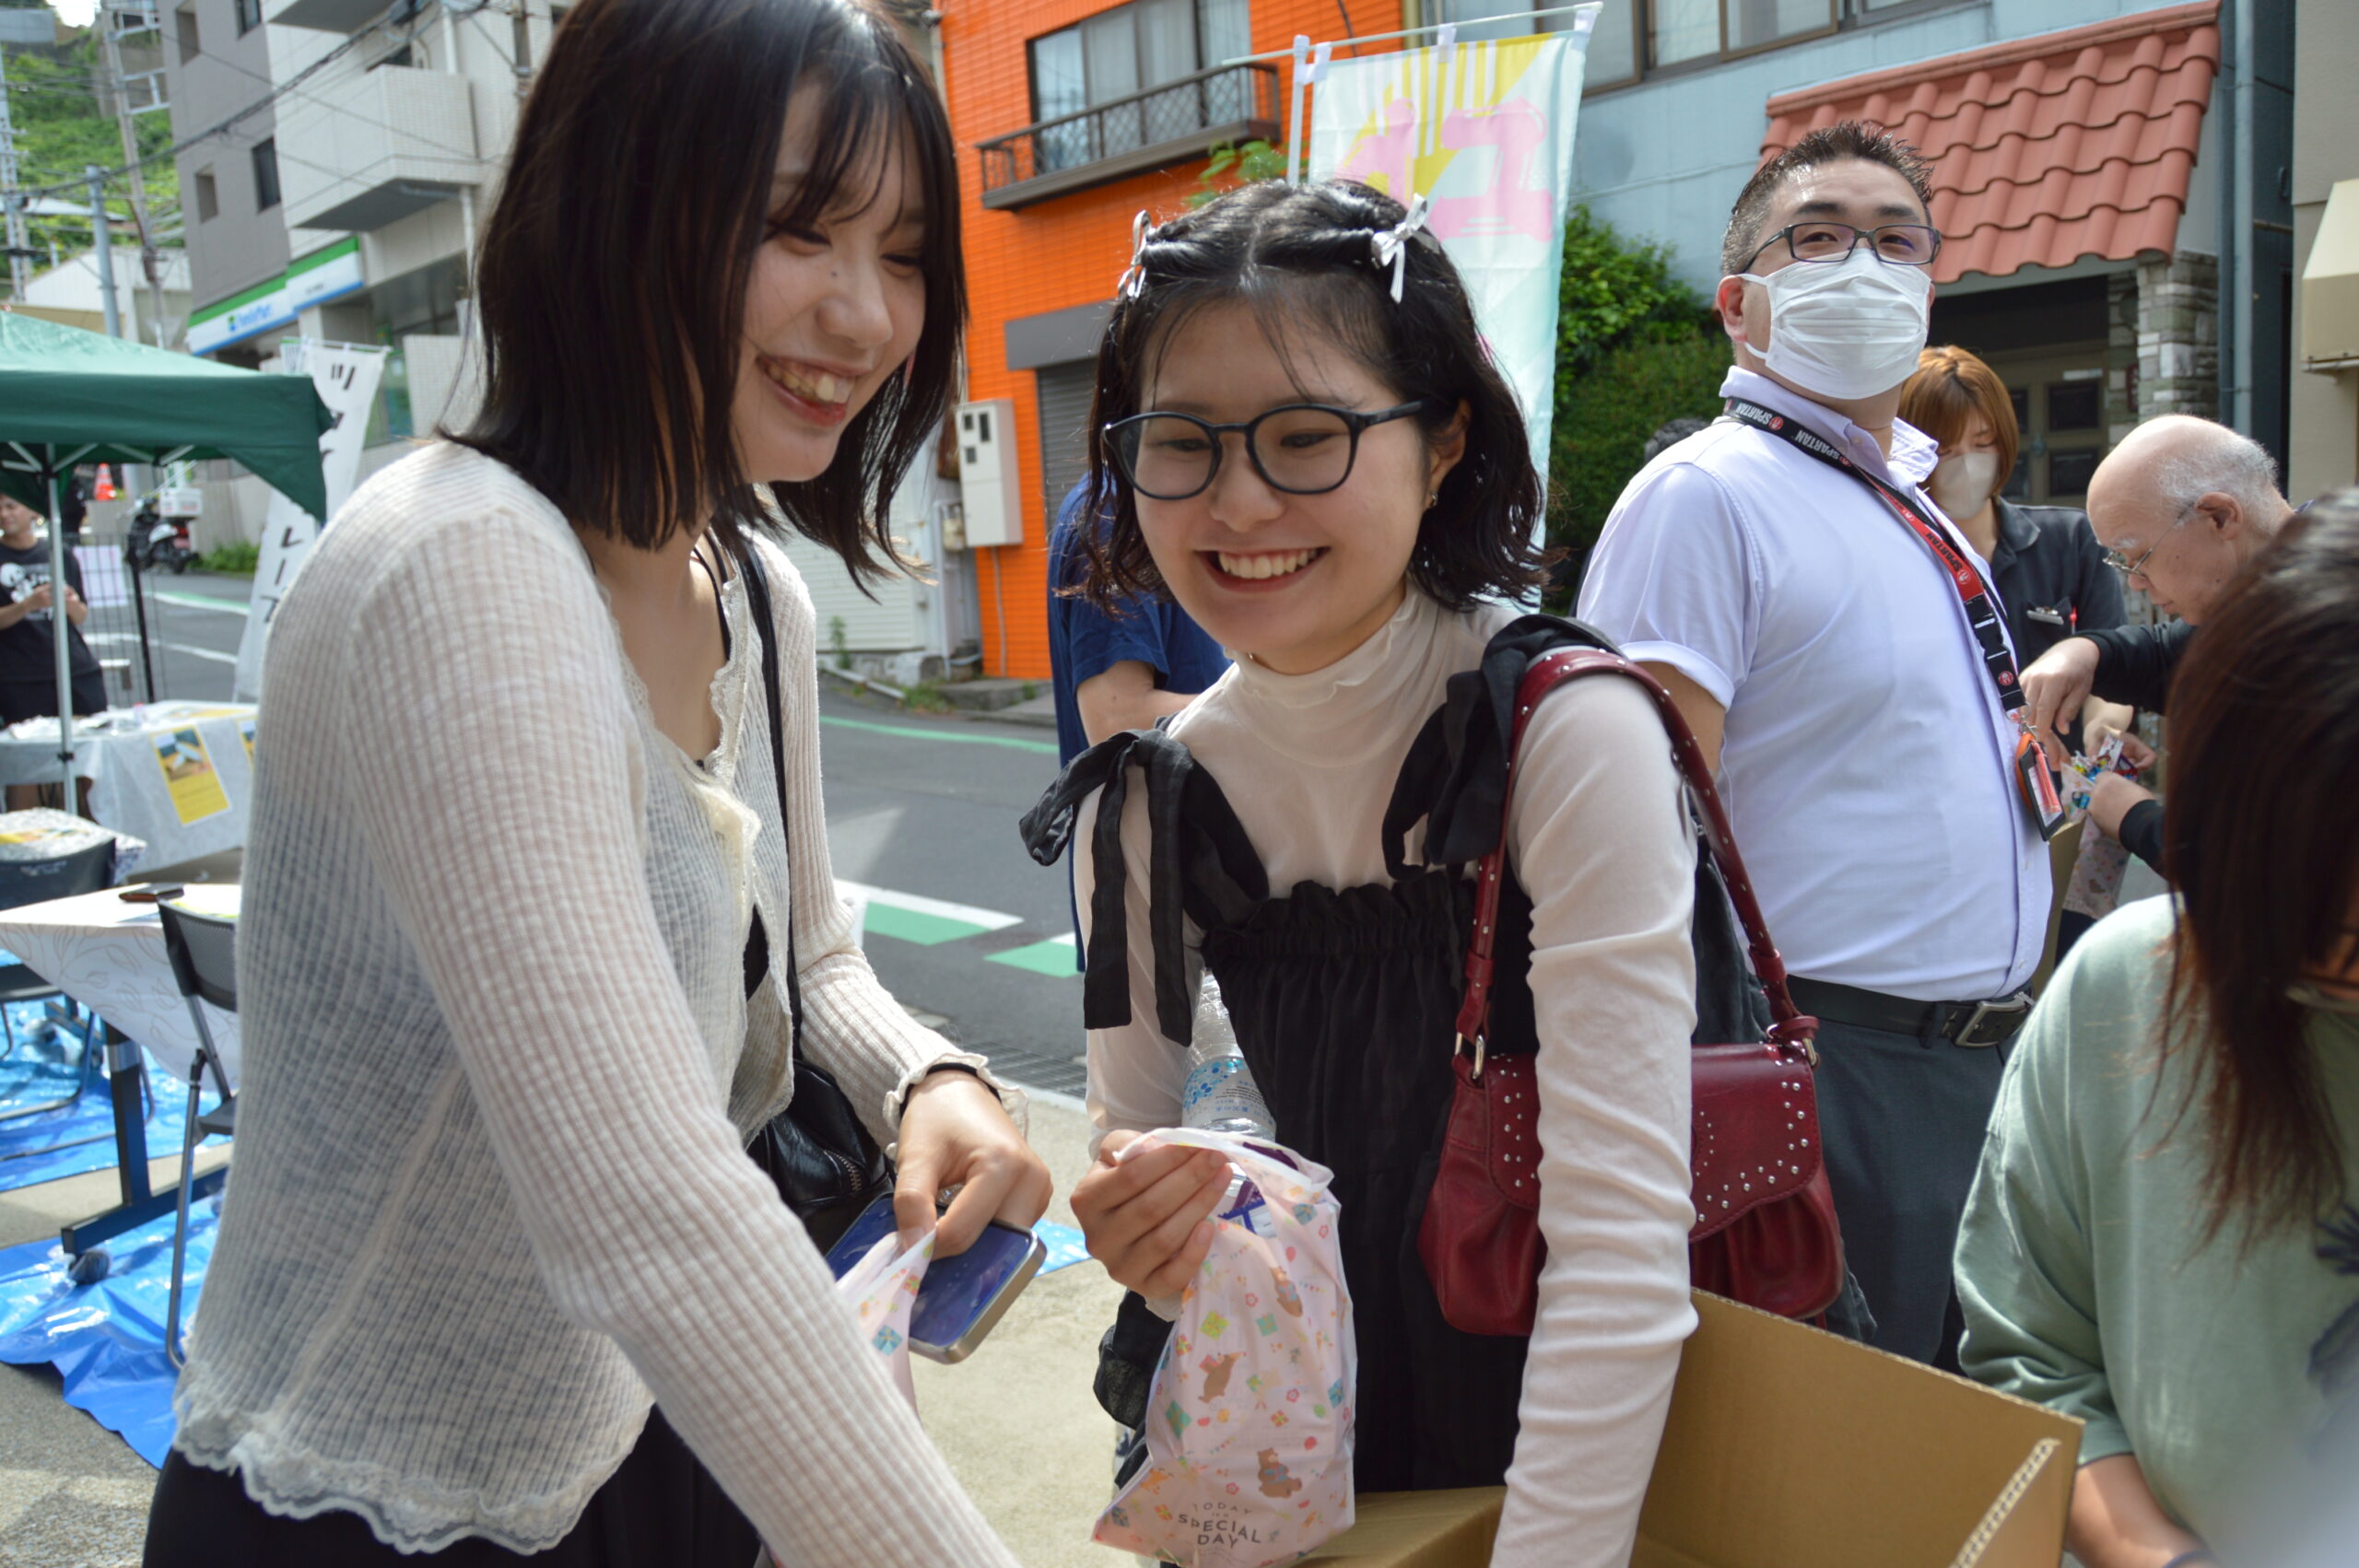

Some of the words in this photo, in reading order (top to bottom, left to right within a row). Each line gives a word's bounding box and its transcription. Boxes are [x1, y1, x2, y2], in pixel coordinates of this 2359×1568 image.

[1735, 403, 1773, 425] SPARTAN
[1794, 429, 1841, 460] SPARTAN
[1926, 532, 1963, 571] SPARTAN
[1192, 1502, 1253, 1515] TODAY
[1178, 1514, 1262, 1544] SPECIAL
[1197, 1533, 1238, 1549] DAY
